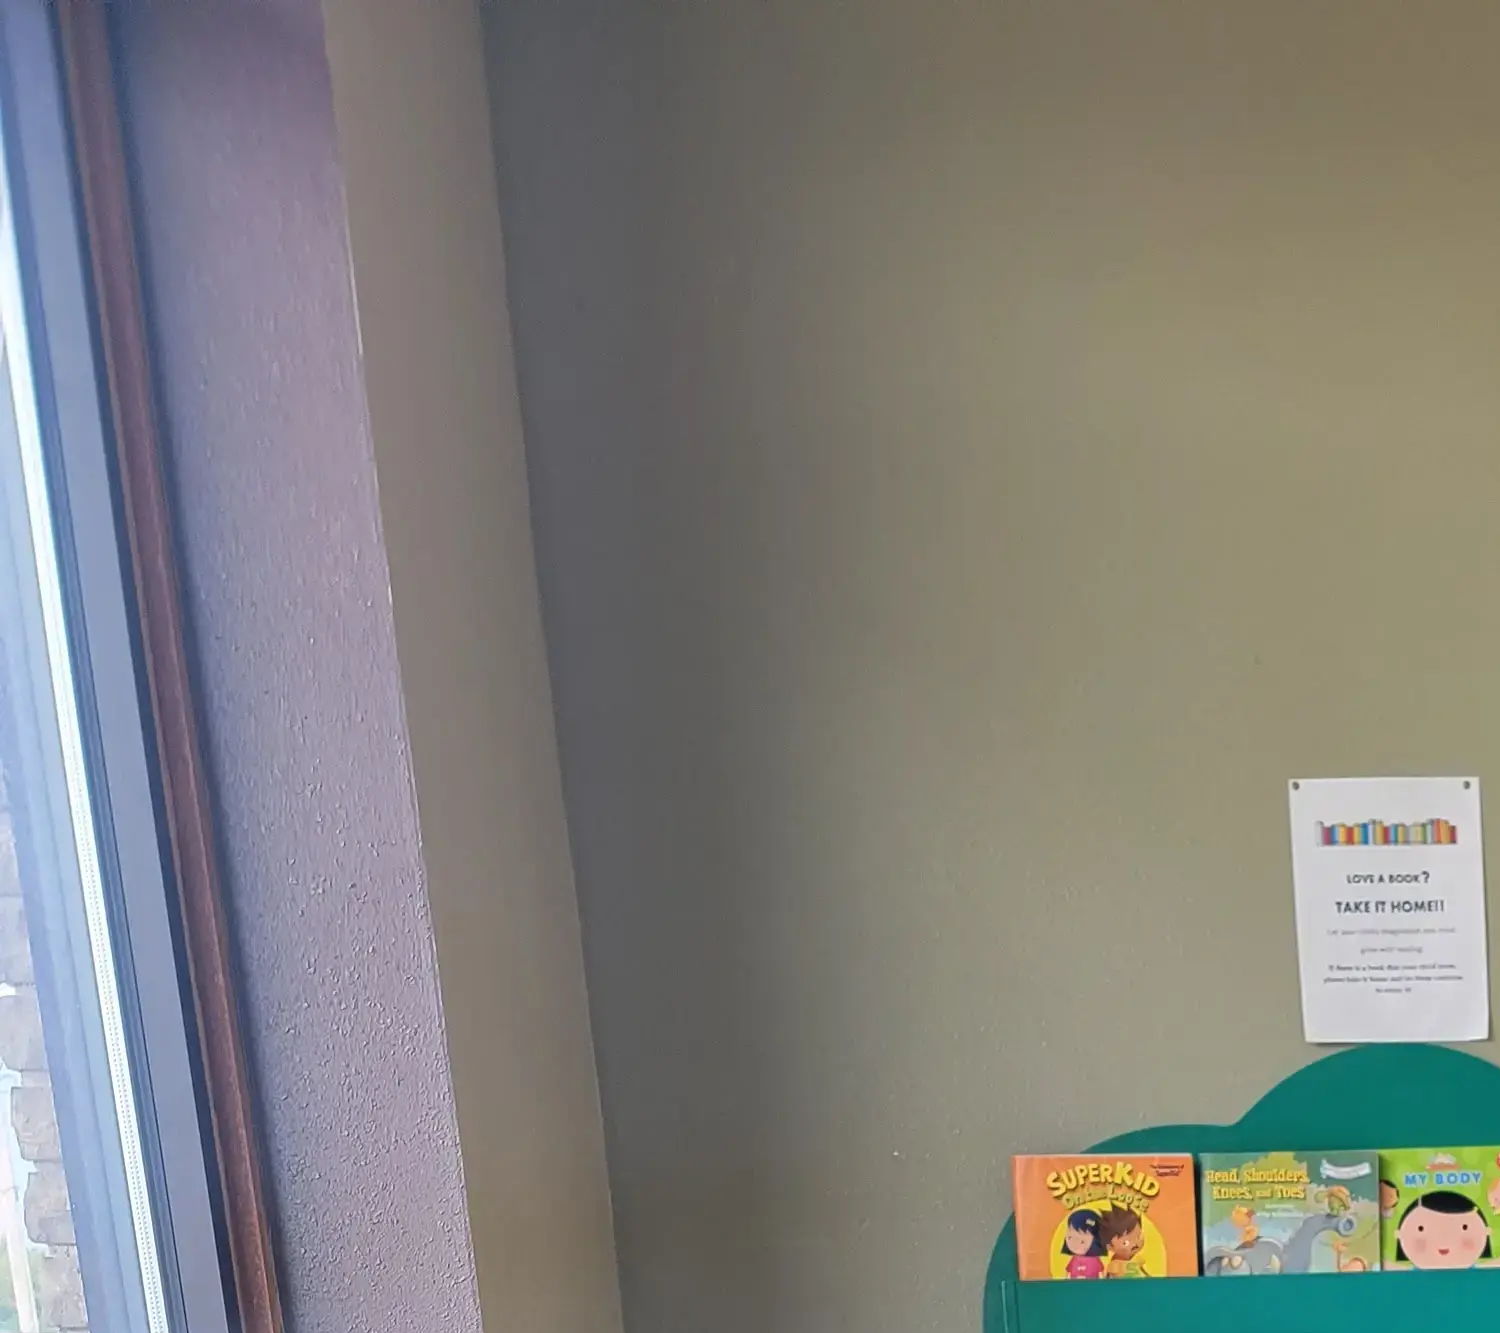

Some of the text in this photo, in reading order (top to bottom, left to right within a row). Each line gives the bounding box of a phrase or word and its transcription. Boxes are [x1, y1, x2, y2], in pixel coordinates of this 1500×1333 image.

[1346, 874, 1375, 884] LOVE
[1378, 874, 1385, 883] A
[1335, 899, 1445, 913] TAKE IT HOME!!
[1404, 1172, 1482, 1186] MY BODY
